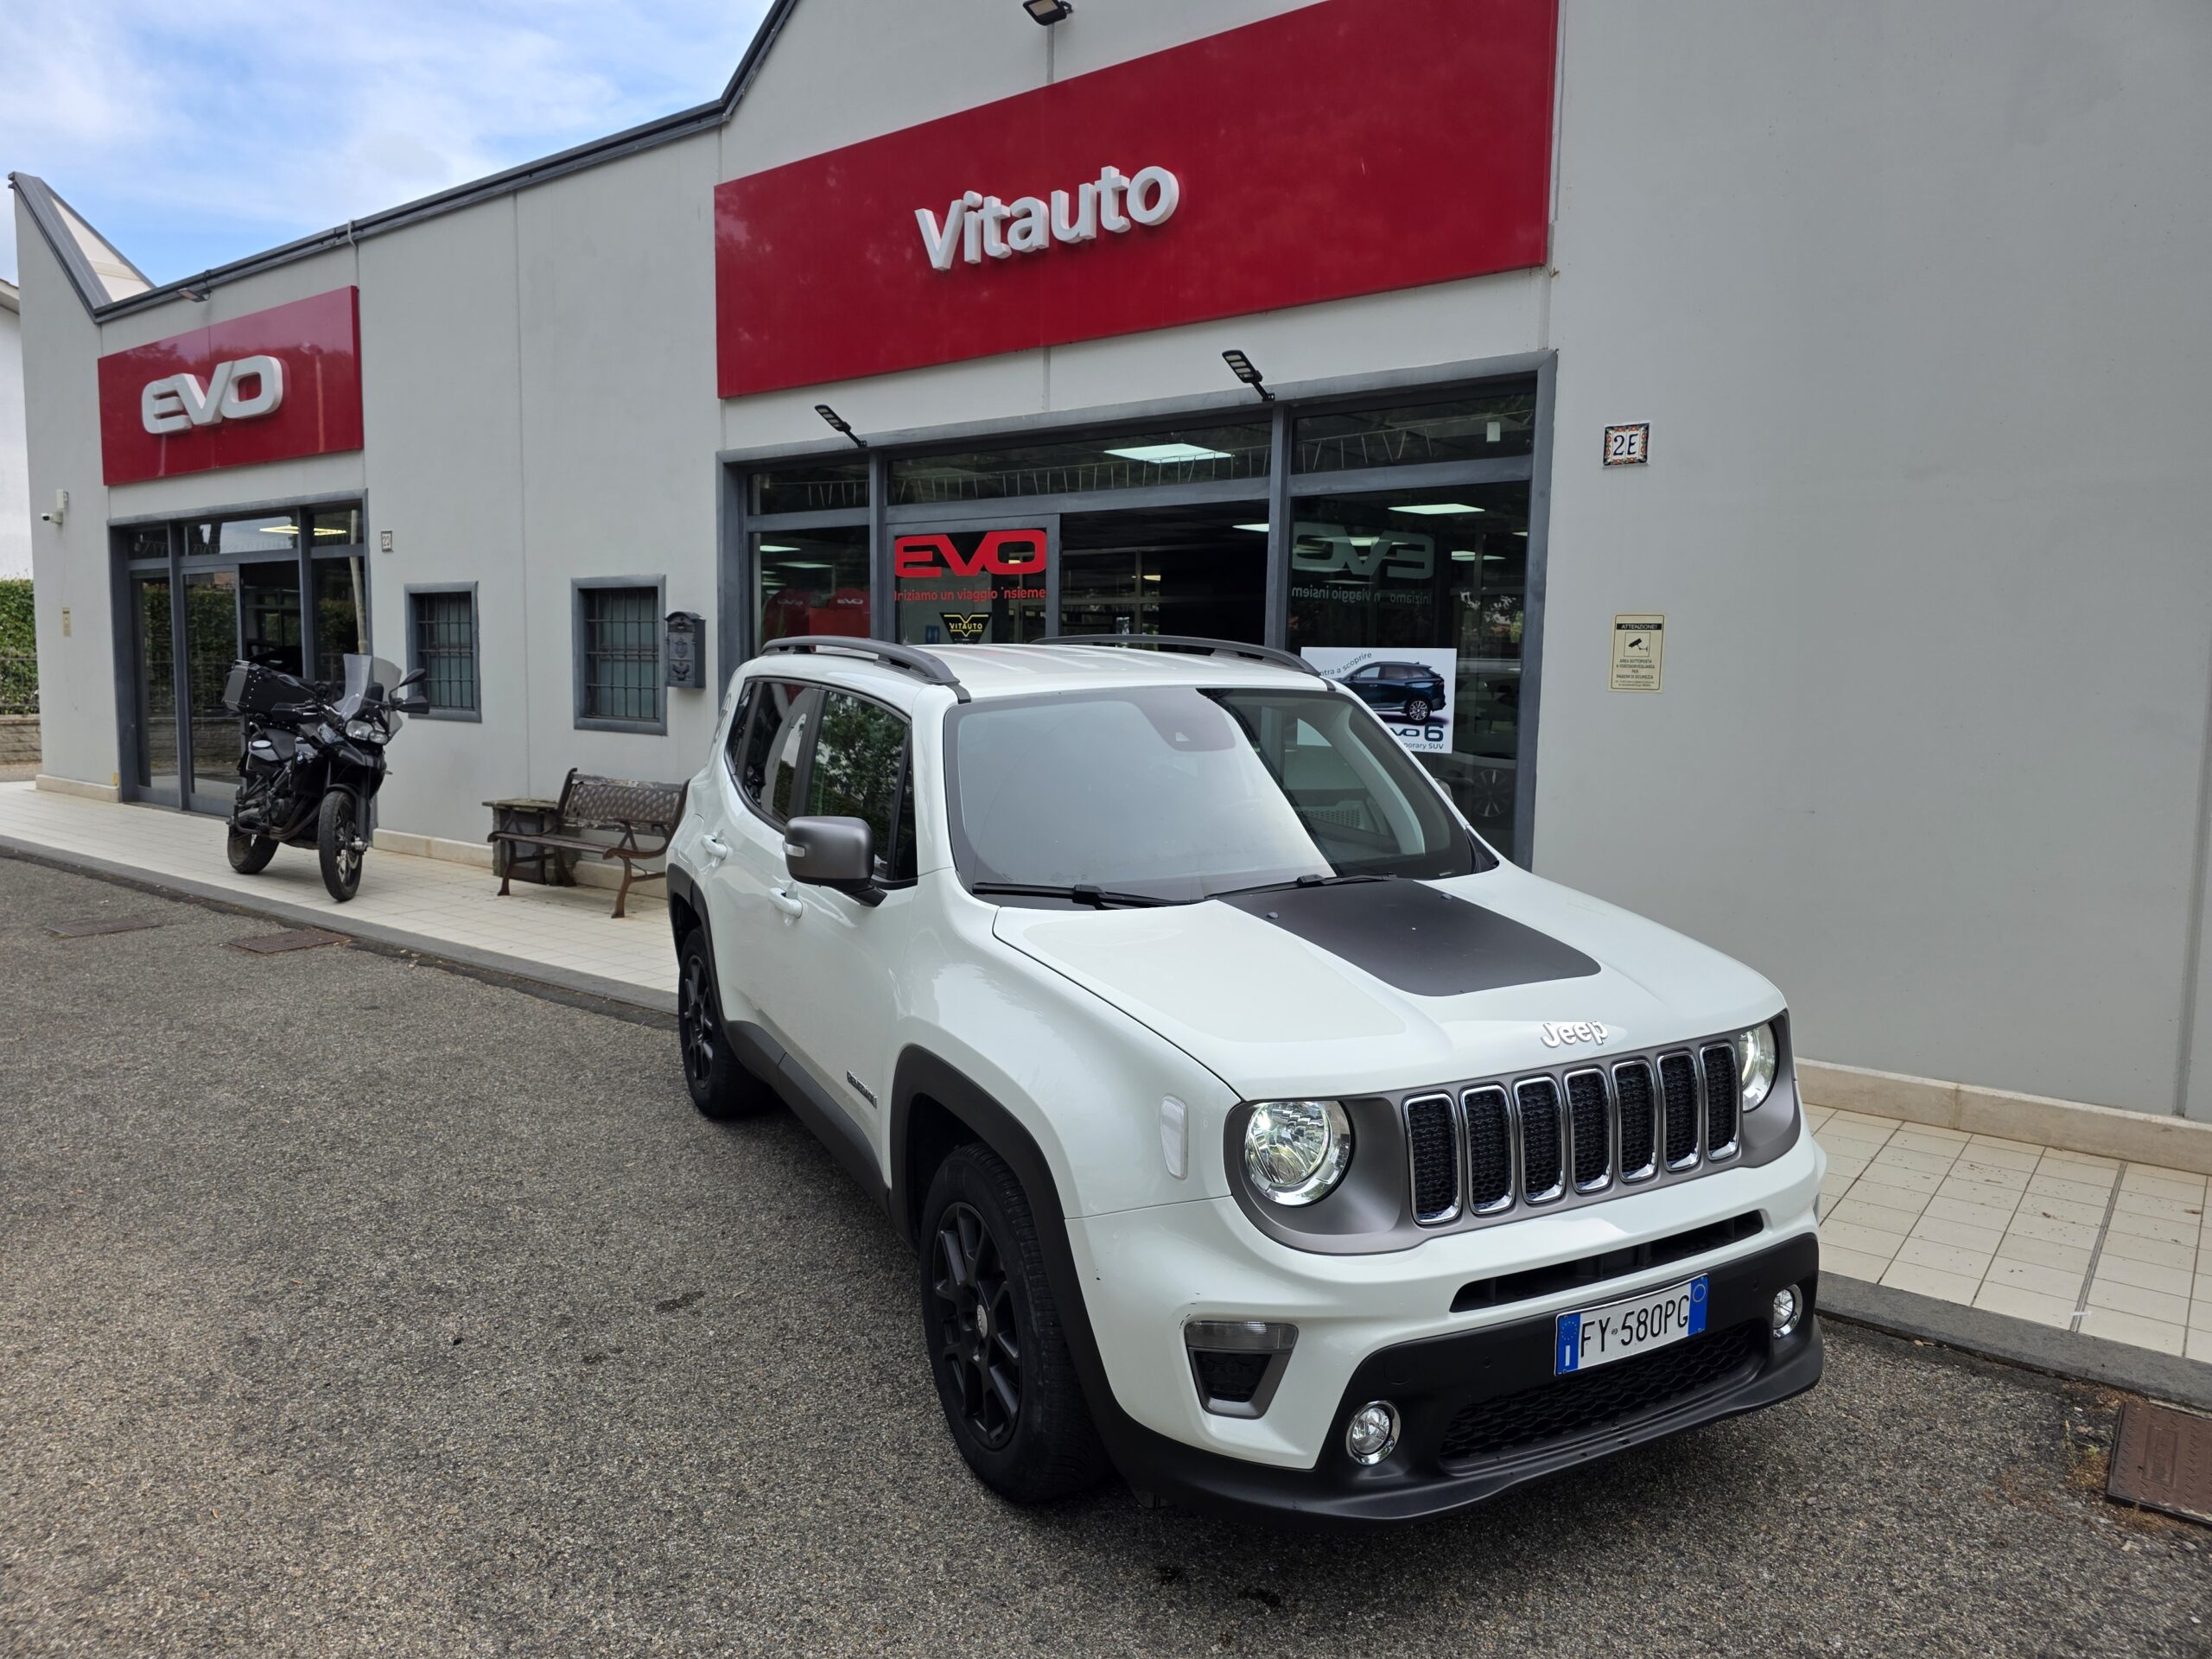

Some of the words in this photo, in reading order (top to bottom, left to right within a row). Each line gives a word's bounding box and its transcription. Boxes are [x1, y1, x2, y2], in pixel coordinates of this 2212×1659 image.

[914, 166, 1179, 271] Vitauto
[142, 354, 284, 435] EVO
[1612, 433, 1638, 456] 2E
[894, 529, 1047, 578] EVO
[941, 591, 955, 601] un
[957, 588, 998, 603] viaggio
[1001, 586, 1046, 600] nsieme
[1320, 668, 1335, 677] ntra
[1342, 652, 1372, 671] scoprire
[1389, 728, 1421, 737] VO
[1424, 722, 1444, 742] 6
[1540, 1020, 1609, 1048] Jeep
